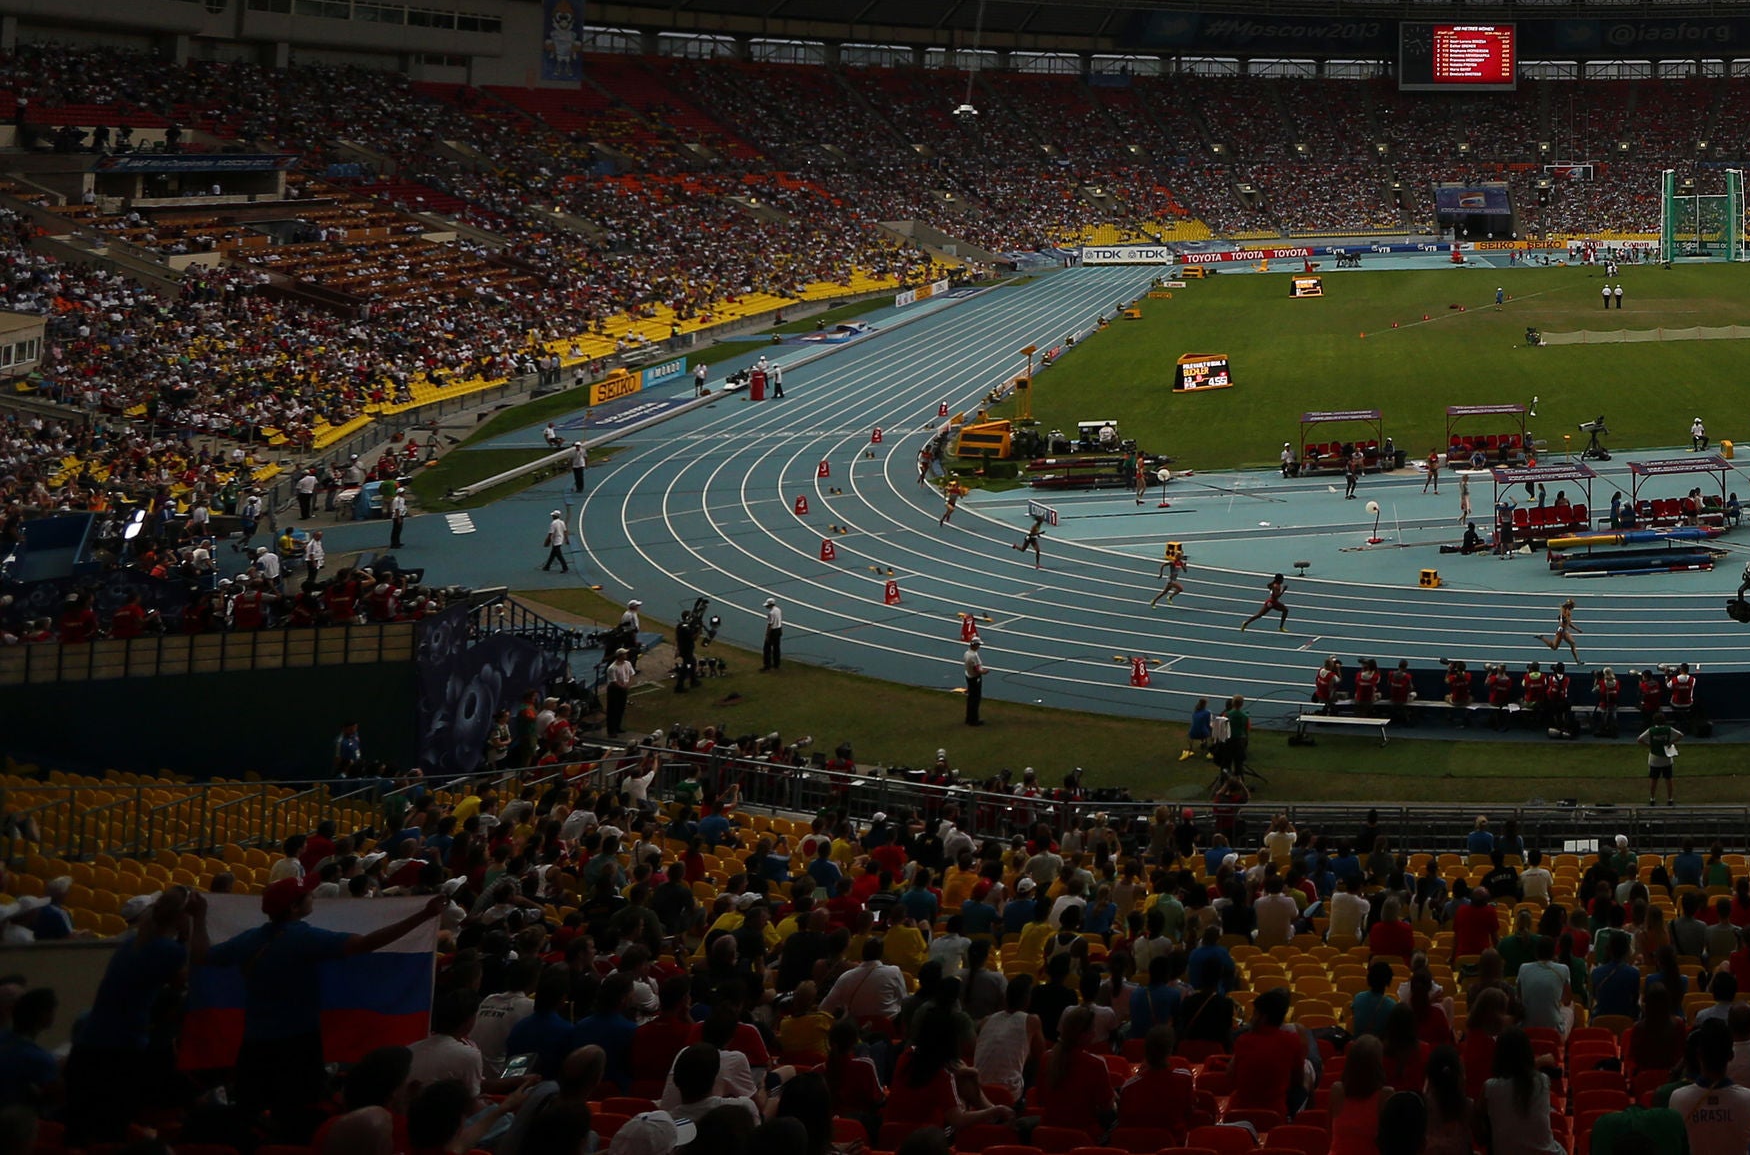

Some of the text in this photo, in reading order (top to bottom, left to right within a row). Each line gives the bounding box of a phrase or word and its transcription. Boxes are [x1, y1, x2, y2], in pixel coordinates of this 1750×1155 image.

[1205, 19, 1380, 40] #Moscow2013
[1606, 22, 1731, 46] @iaaforg
[1480, 241, 1515, 250] SEIKO
[1527, 240, 1562, 249] SEIKO
[1093, 250, 1121, 259] TDK
[1136, 250, 1164, 258] TDK
[1187, 253, 1222, 263] TOYOTA
[1231, 250, 1264, 261] TOYOTA
[1273, 248, 1308, 257] TOYOTA
[597, 375, 636, 402] SEIKO
[820, 462, 827, 471] 3
[798, 497, 805, 507] 4
[824, 542, 832, 553] 5
[888, 585, 896, 596] 6
[966, 620, 973, 631] 7
[1139, 663, 1145, 674] 8
[1691, 1108, 1736, 1123] BRASIL
